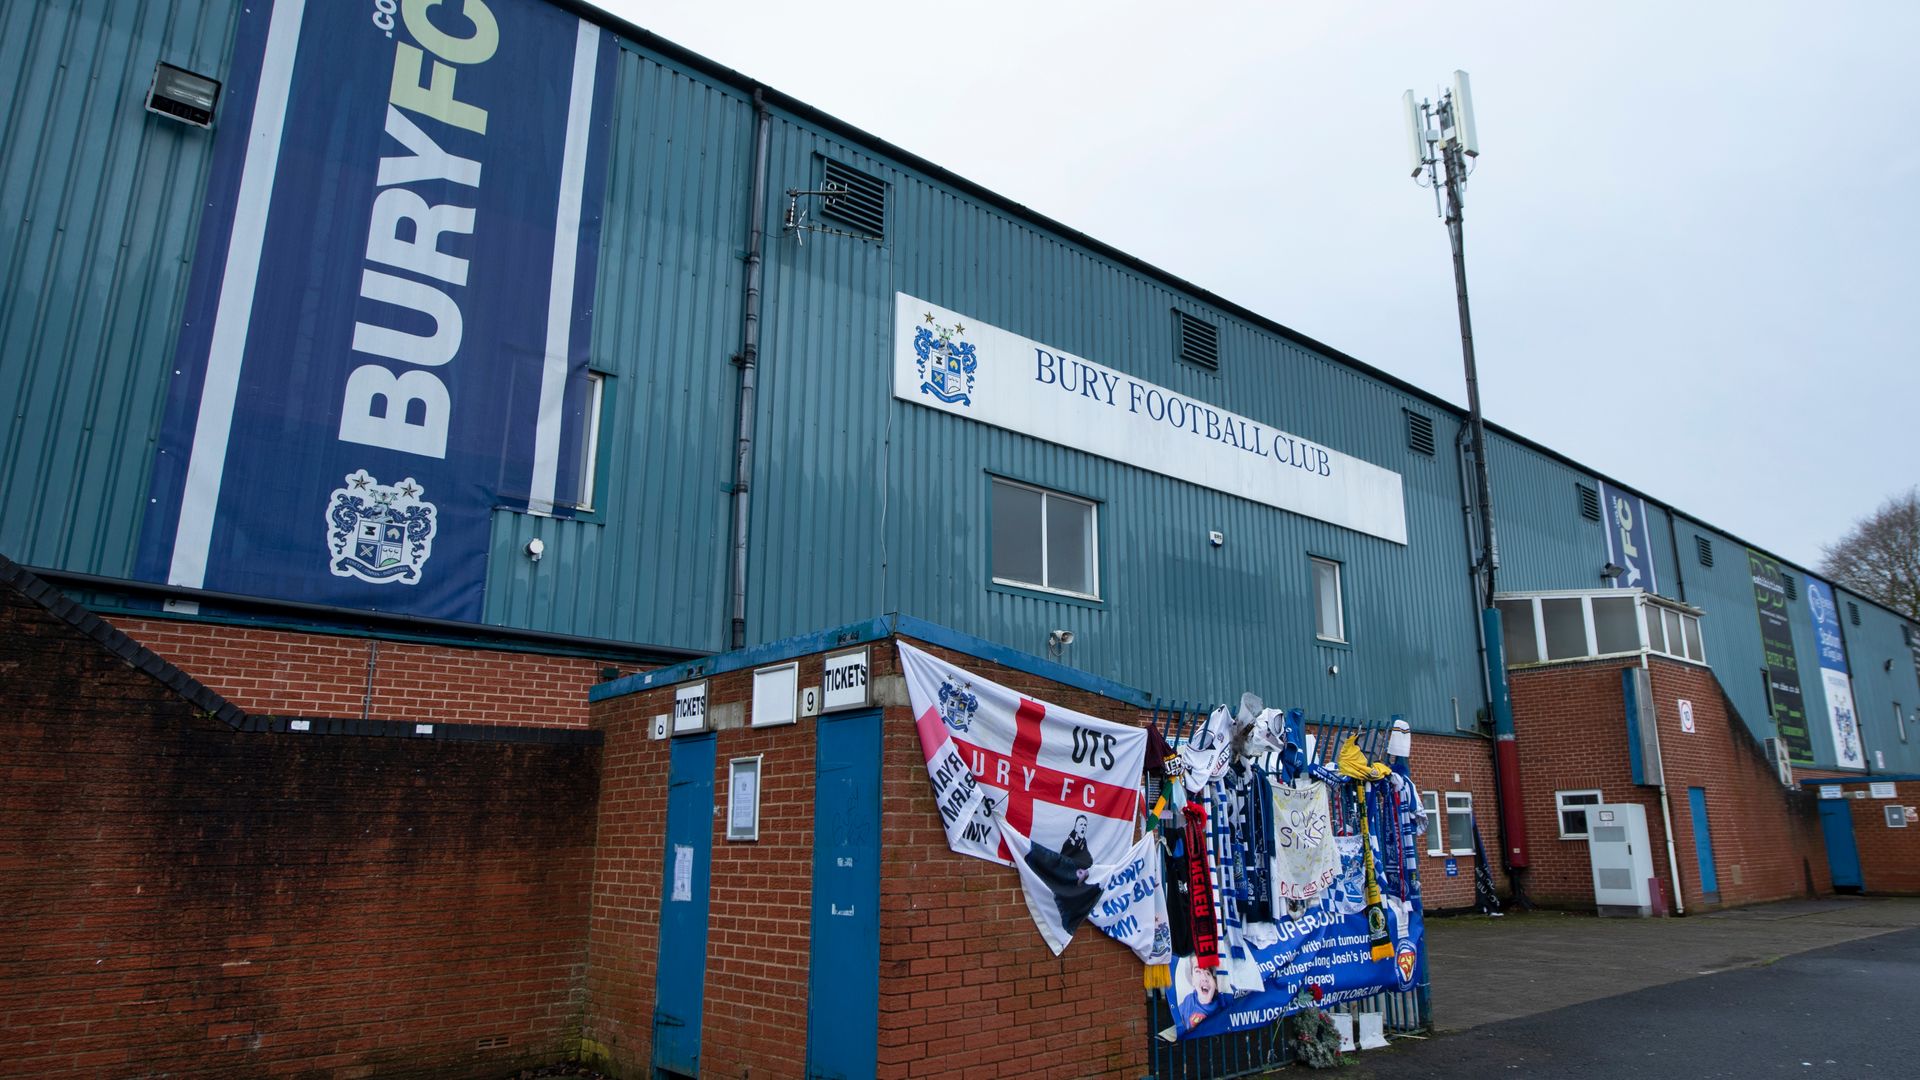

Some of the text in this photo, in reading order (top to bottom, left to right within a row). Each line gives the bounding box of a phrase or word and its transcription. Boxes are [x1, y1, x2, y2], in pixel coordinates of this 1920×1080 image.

[1035, 348, 1331, 477] BURY FOOTBALL CLUB
[1618, 498, 1642, 588] YFC
[825, 663, 866, 692] TICKETS
[676, 696, 705, 718] TICKETS
[807, 691, 814, 711] 9
[1071, 725, 1117, 771] UTS
[955, 743, 1037, 792] URY
[1257, 961, 1276, 973] ing
[1301, 940, 1321, 954] with
[1338, 934, 1372, 946] tumour
[1312, 956, 1331, 968] long
[1331, 951, 1359, 965] Josh's
[1288, 981, 1297, 994] in
